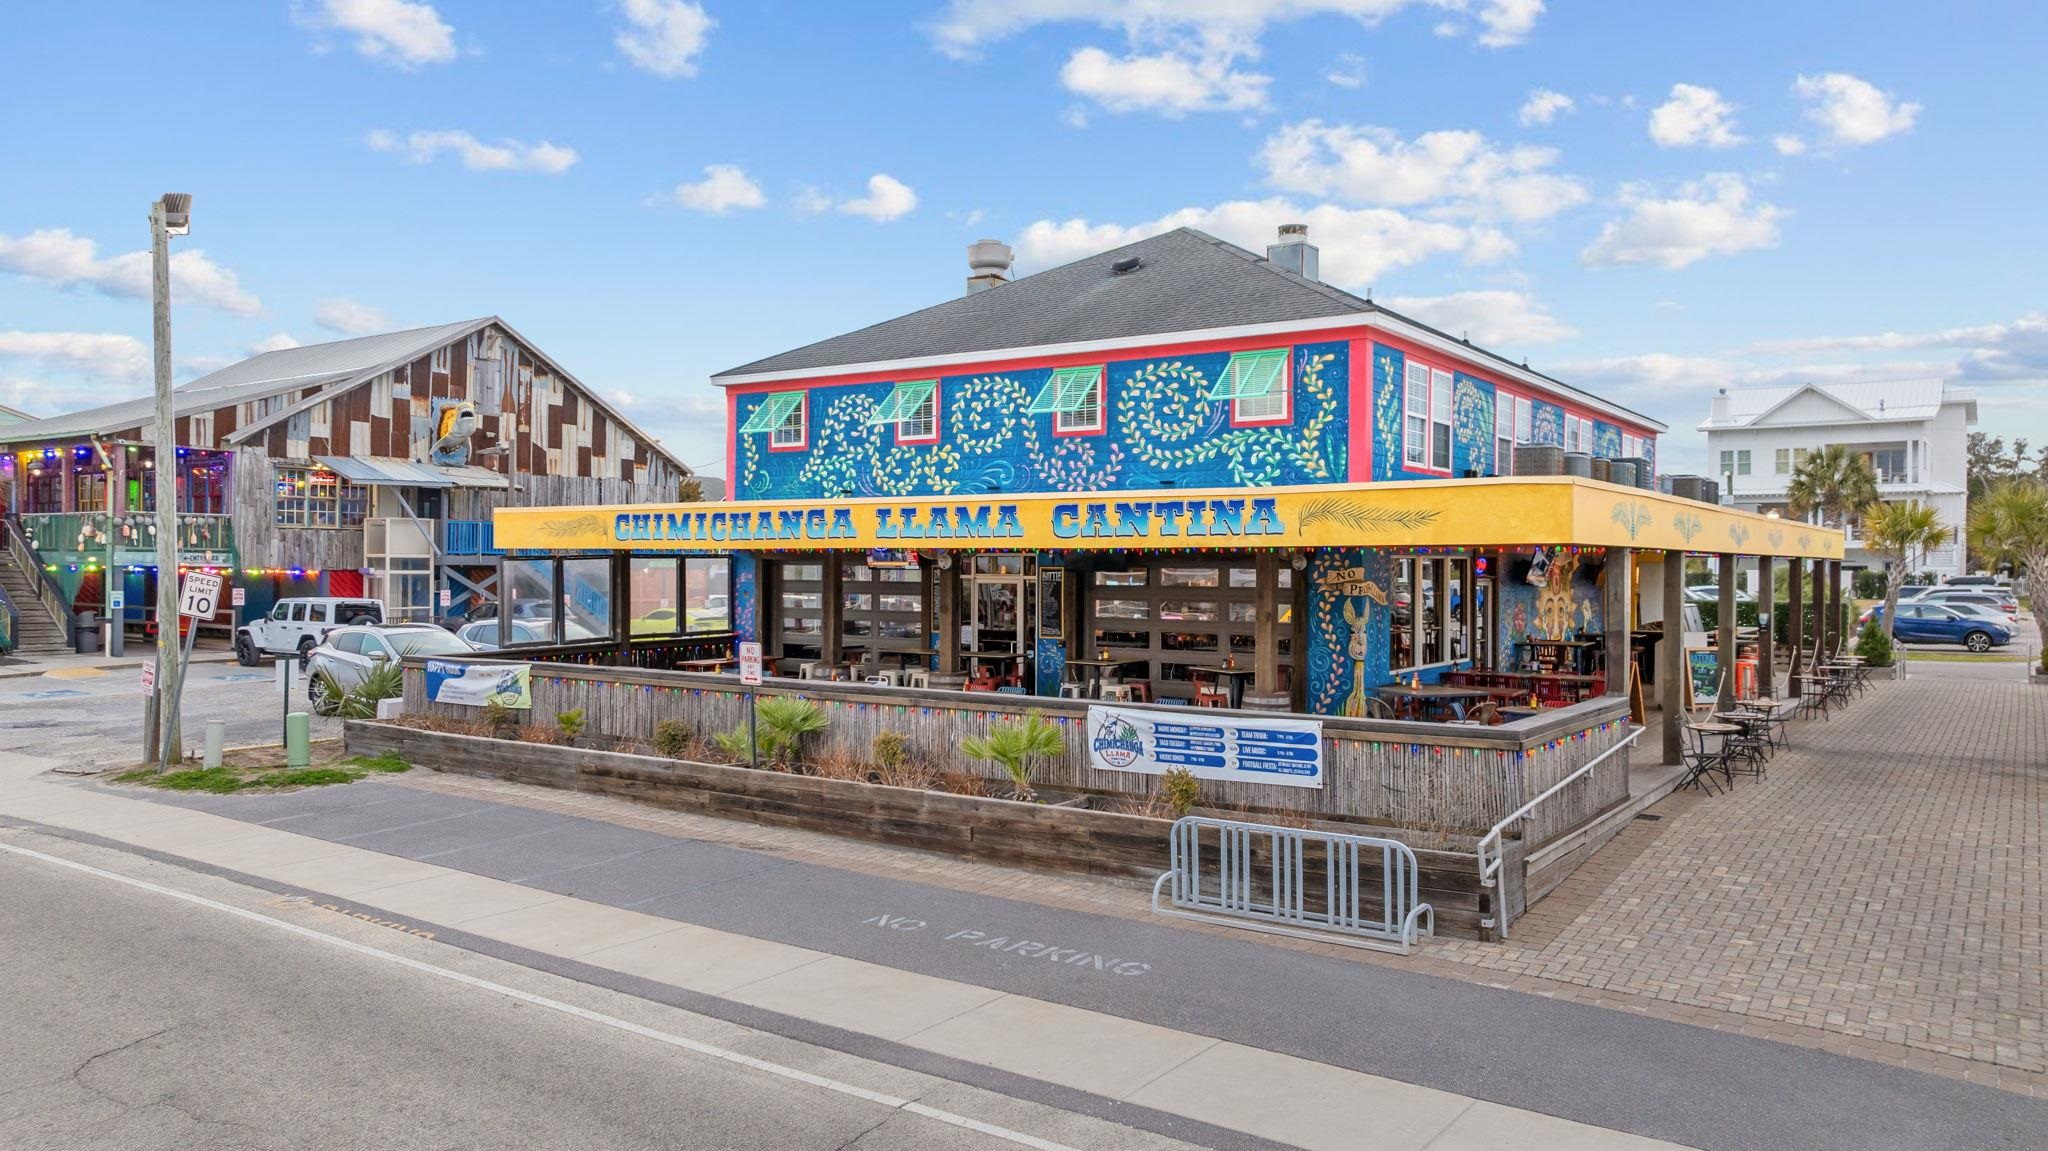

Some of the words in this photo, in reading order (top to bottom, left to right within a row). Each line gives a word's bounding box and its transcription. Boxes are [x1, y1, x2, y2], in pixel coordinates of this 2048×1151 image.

[614, 508, 857, 541] CHIMICHANGA
[875, 504, 1024, 539] LLAMA
[1051, 498, 1285, 538] CANTINA
[1336, 570, 1355, 581] NO
[188, 575, 218, 588] SPEED
[189, 585, 213, 596] LIMIT
[188, 595, 211, 613] 10
[746, 646, 755, 655] NO
[741, 655, 760, 664] PARKING
[1093, 737, 1144, 757] CHIMICHANGA
[1242, 746, 1252, 754] LIVE
[1105, 750, 1131, 759] LLAMA
[1242, 760, 1262, 769] FOOTBALL
[862, 913, 928, 931] NO
[943, 928, 1152, 976] PARKING
